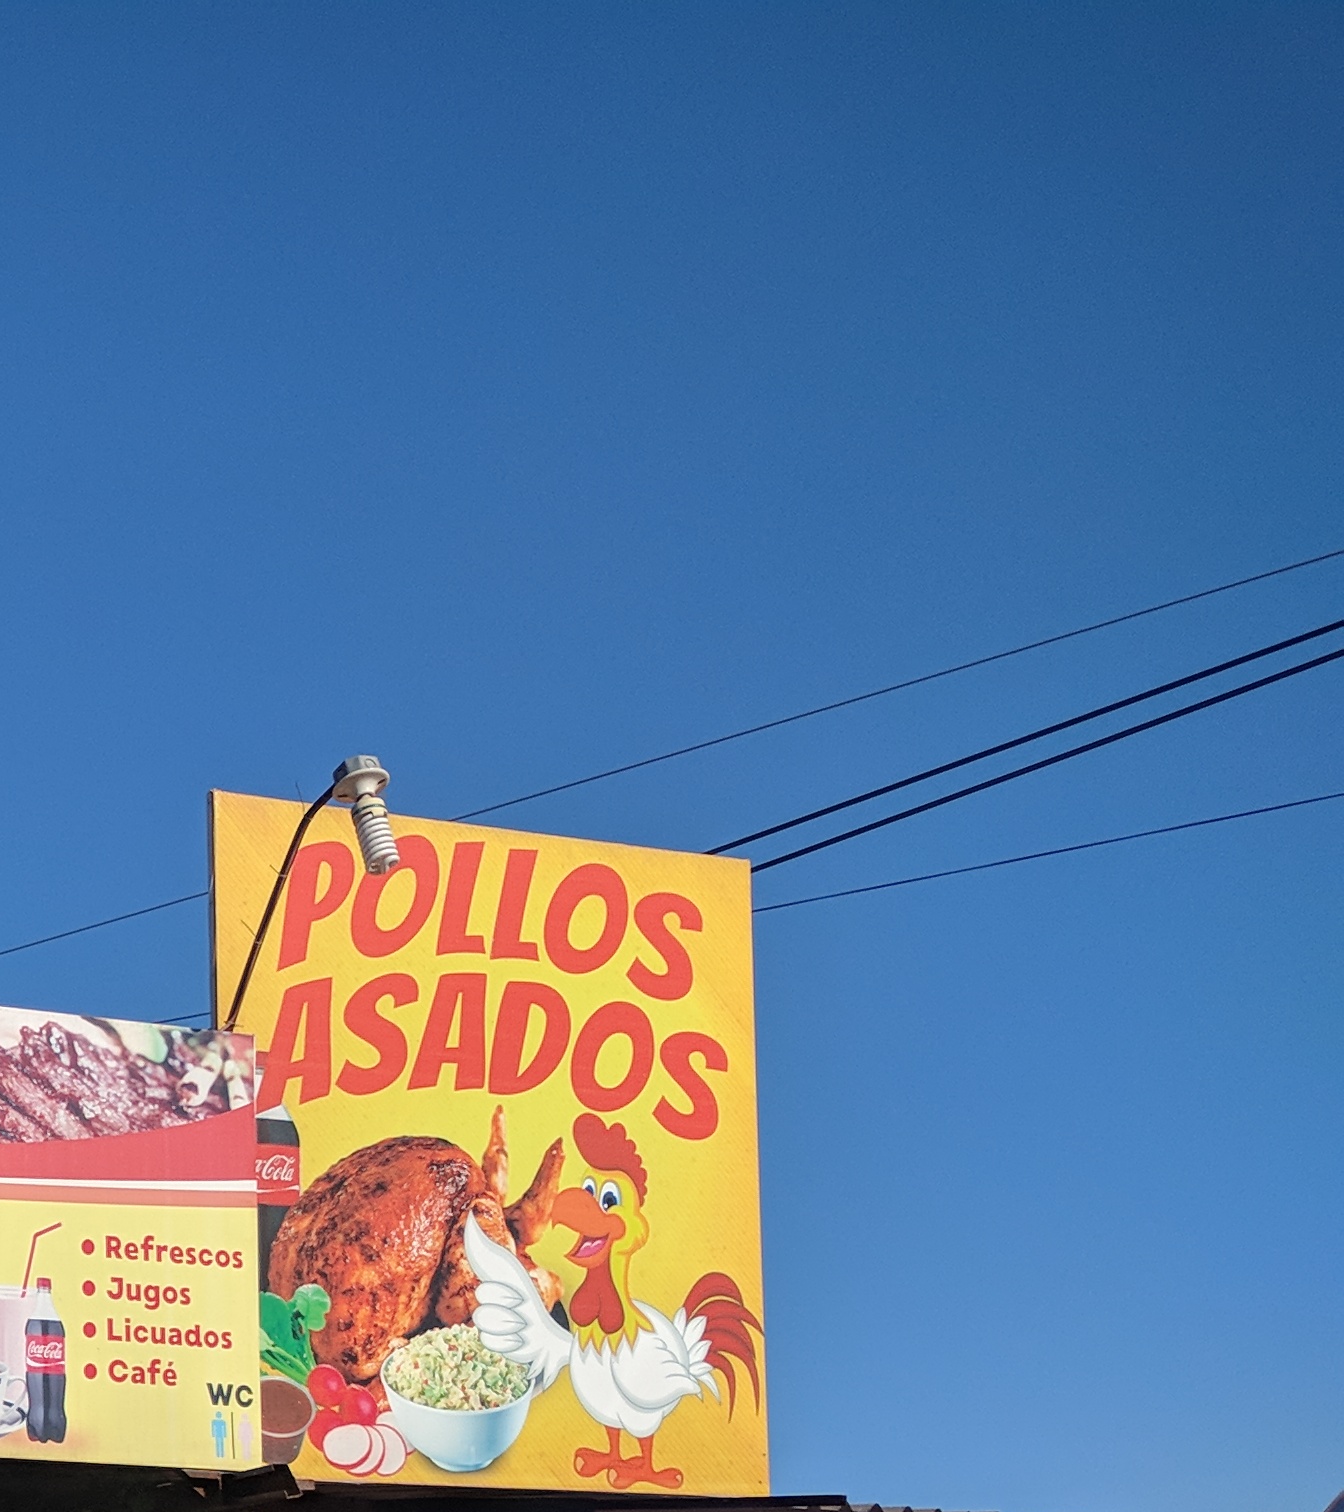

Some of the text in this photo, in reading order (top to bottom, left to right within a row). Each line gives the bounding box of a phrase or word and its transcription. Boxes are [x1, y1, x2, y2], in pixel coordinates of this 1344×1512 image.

[277, 835, 703, 1001] POLLOS
[257, 972, 728, 1141] ASADOS
[105, 1236, 244, 1269] Refrescos
[107, 1278, 191, 1311] Jugos
[107, 1319, 233, 1349] Licuados
[108, 1358, 178, 1386] Café
[207, 1383, 254, 1408] WC
